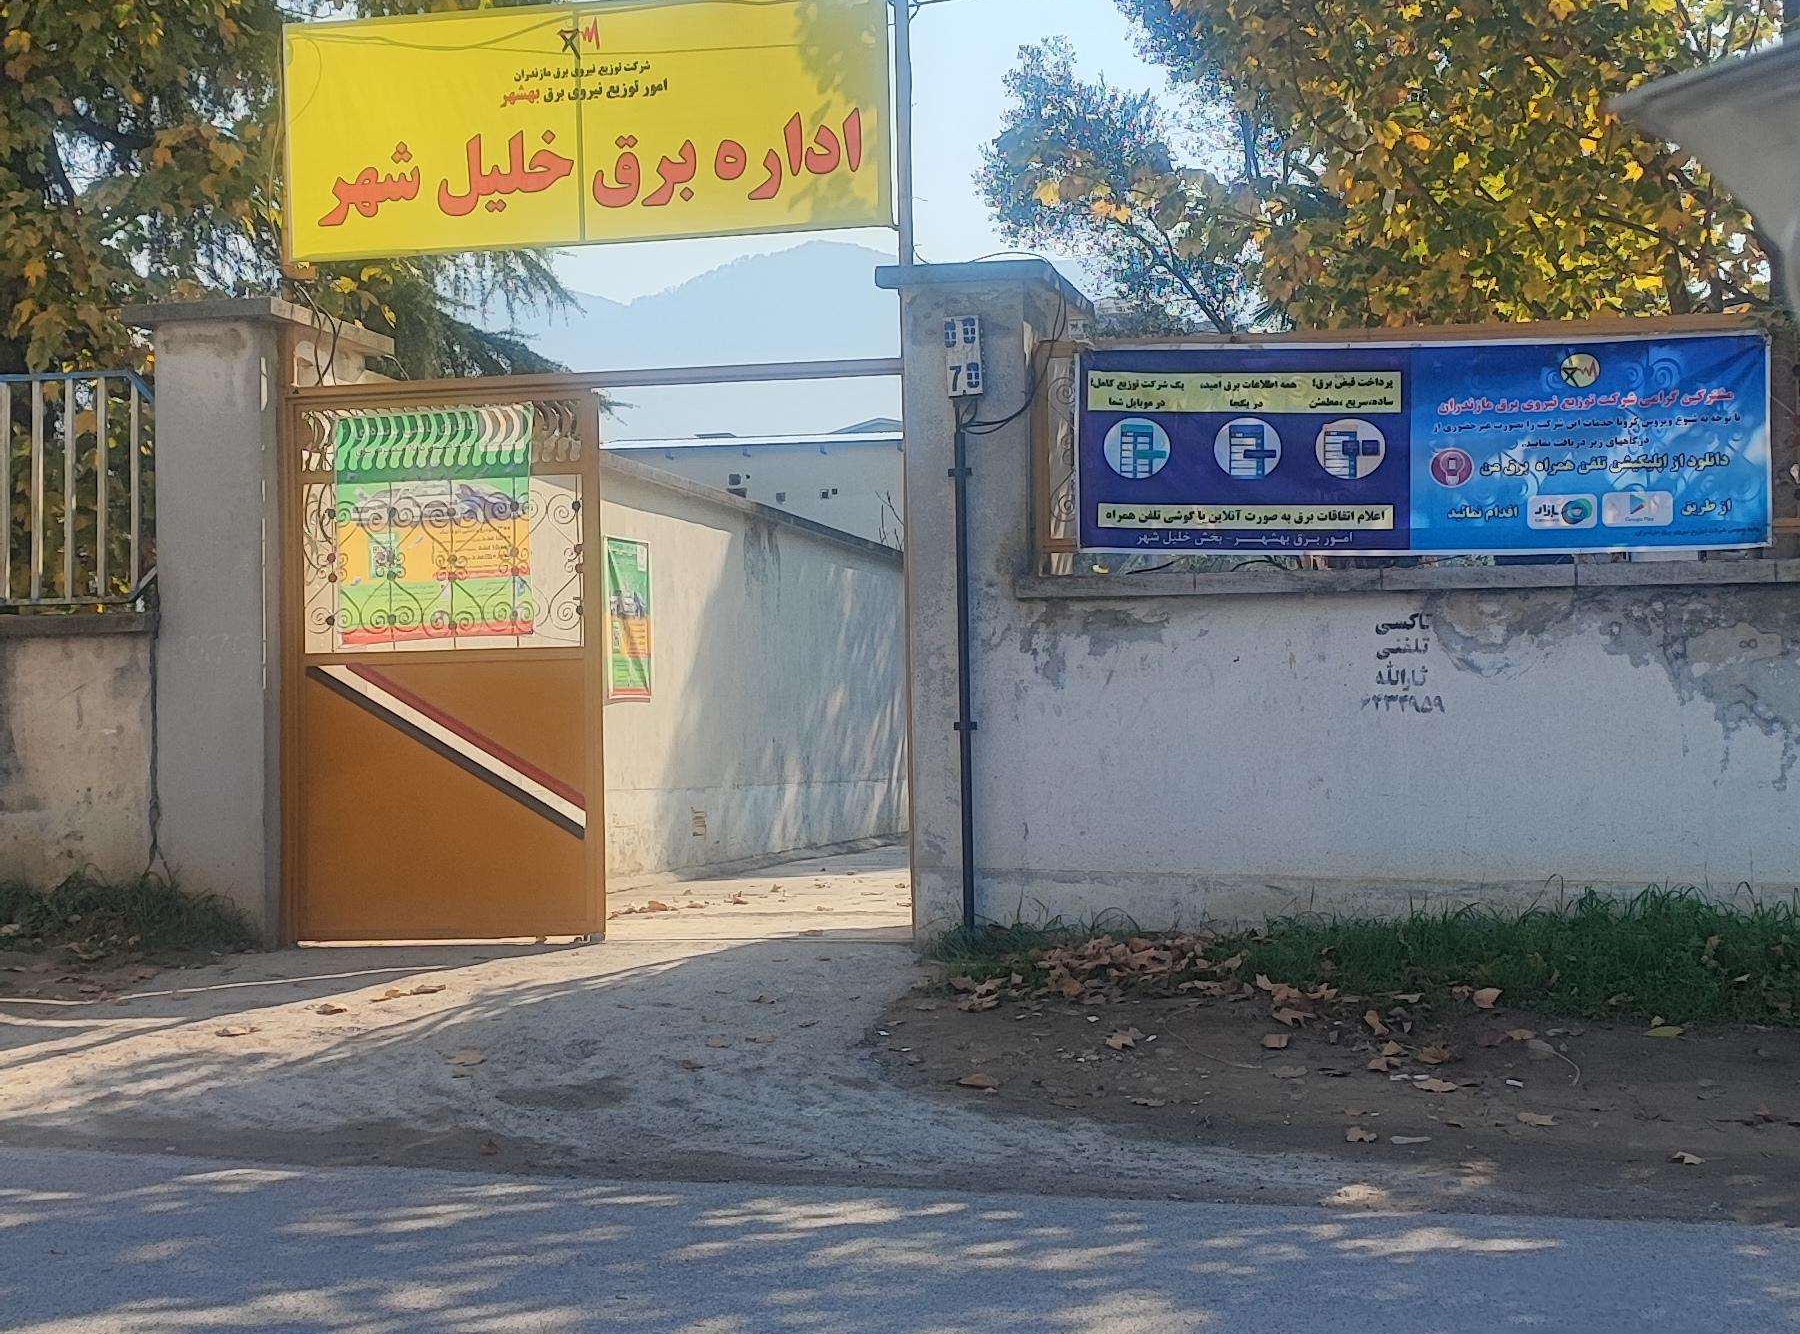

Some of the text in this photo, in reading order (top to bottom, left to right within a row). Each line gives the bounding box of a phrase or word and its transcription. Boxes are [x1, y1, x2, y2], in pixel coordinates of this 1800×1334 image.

[514, 61, 651, 81] شرکت توزیع نیروی برق مازندران
[500, 78, 668, 107] امور توزیع نیروی برق بهشهر
[318, 107, 861, 227] اداره برق خلیل شهر
[1117, 379, 1139, 390] توزیع
[1141, 380, 1168, 390] شرکت
[1170, 381, 1184, 391] یک
[1224, 381, 1240, 392] برق
[1242, 380, 1277, 389] اطلاعات
[1335, 377, 1356, 389] قبض
[1358, 377, 1393, 389] پرداخت
[1109, 397, 1165, 409] در موبایل شما
[1230, 399, 1263, 409] در یکجا
[1438, 388, 1734, 416] مشترکین گرامی شرکت توزیع نیروی برق مازندران
[1444, 423, 1476, 433] حضوری
[1527, 421, 1535, 431] را
[1537, 420, 1564, 430] شرکت
[1583, 419, 1613, 427] خدمات
[1617, 416, 1639, 428] کرونا
[1642, 418, 1672, 428] ویروس
[1554, 438, 1586, 448] دریافت
[1479, 452, 1729, 476] دانلود از اپلیکیشن تلفن همراه برق من
[1485, 505, 1519, 522] اقدام
[1681, 498, 1733, 517] از طریق
[1106, 509, 1385, 524] اعلام اتفاقات برق به صورت آنلاین با گوشی تلفن همراه
[1137, 531, 1160, 546] شهر
[1163, 531, 1191, 545] خلیل
[1194, 532, 1223, 546] بخش
[1233, 533, 1290, 546] بهشهر
[1293, 534, 1320, 546] برق
[1324, 532, 1353, 546] امور
[1375, 612, 1432, 635] تاکسی
[1377, 637, 1429, 660] تلفنی
[1376, 661, 1428, 691] ثارالله
